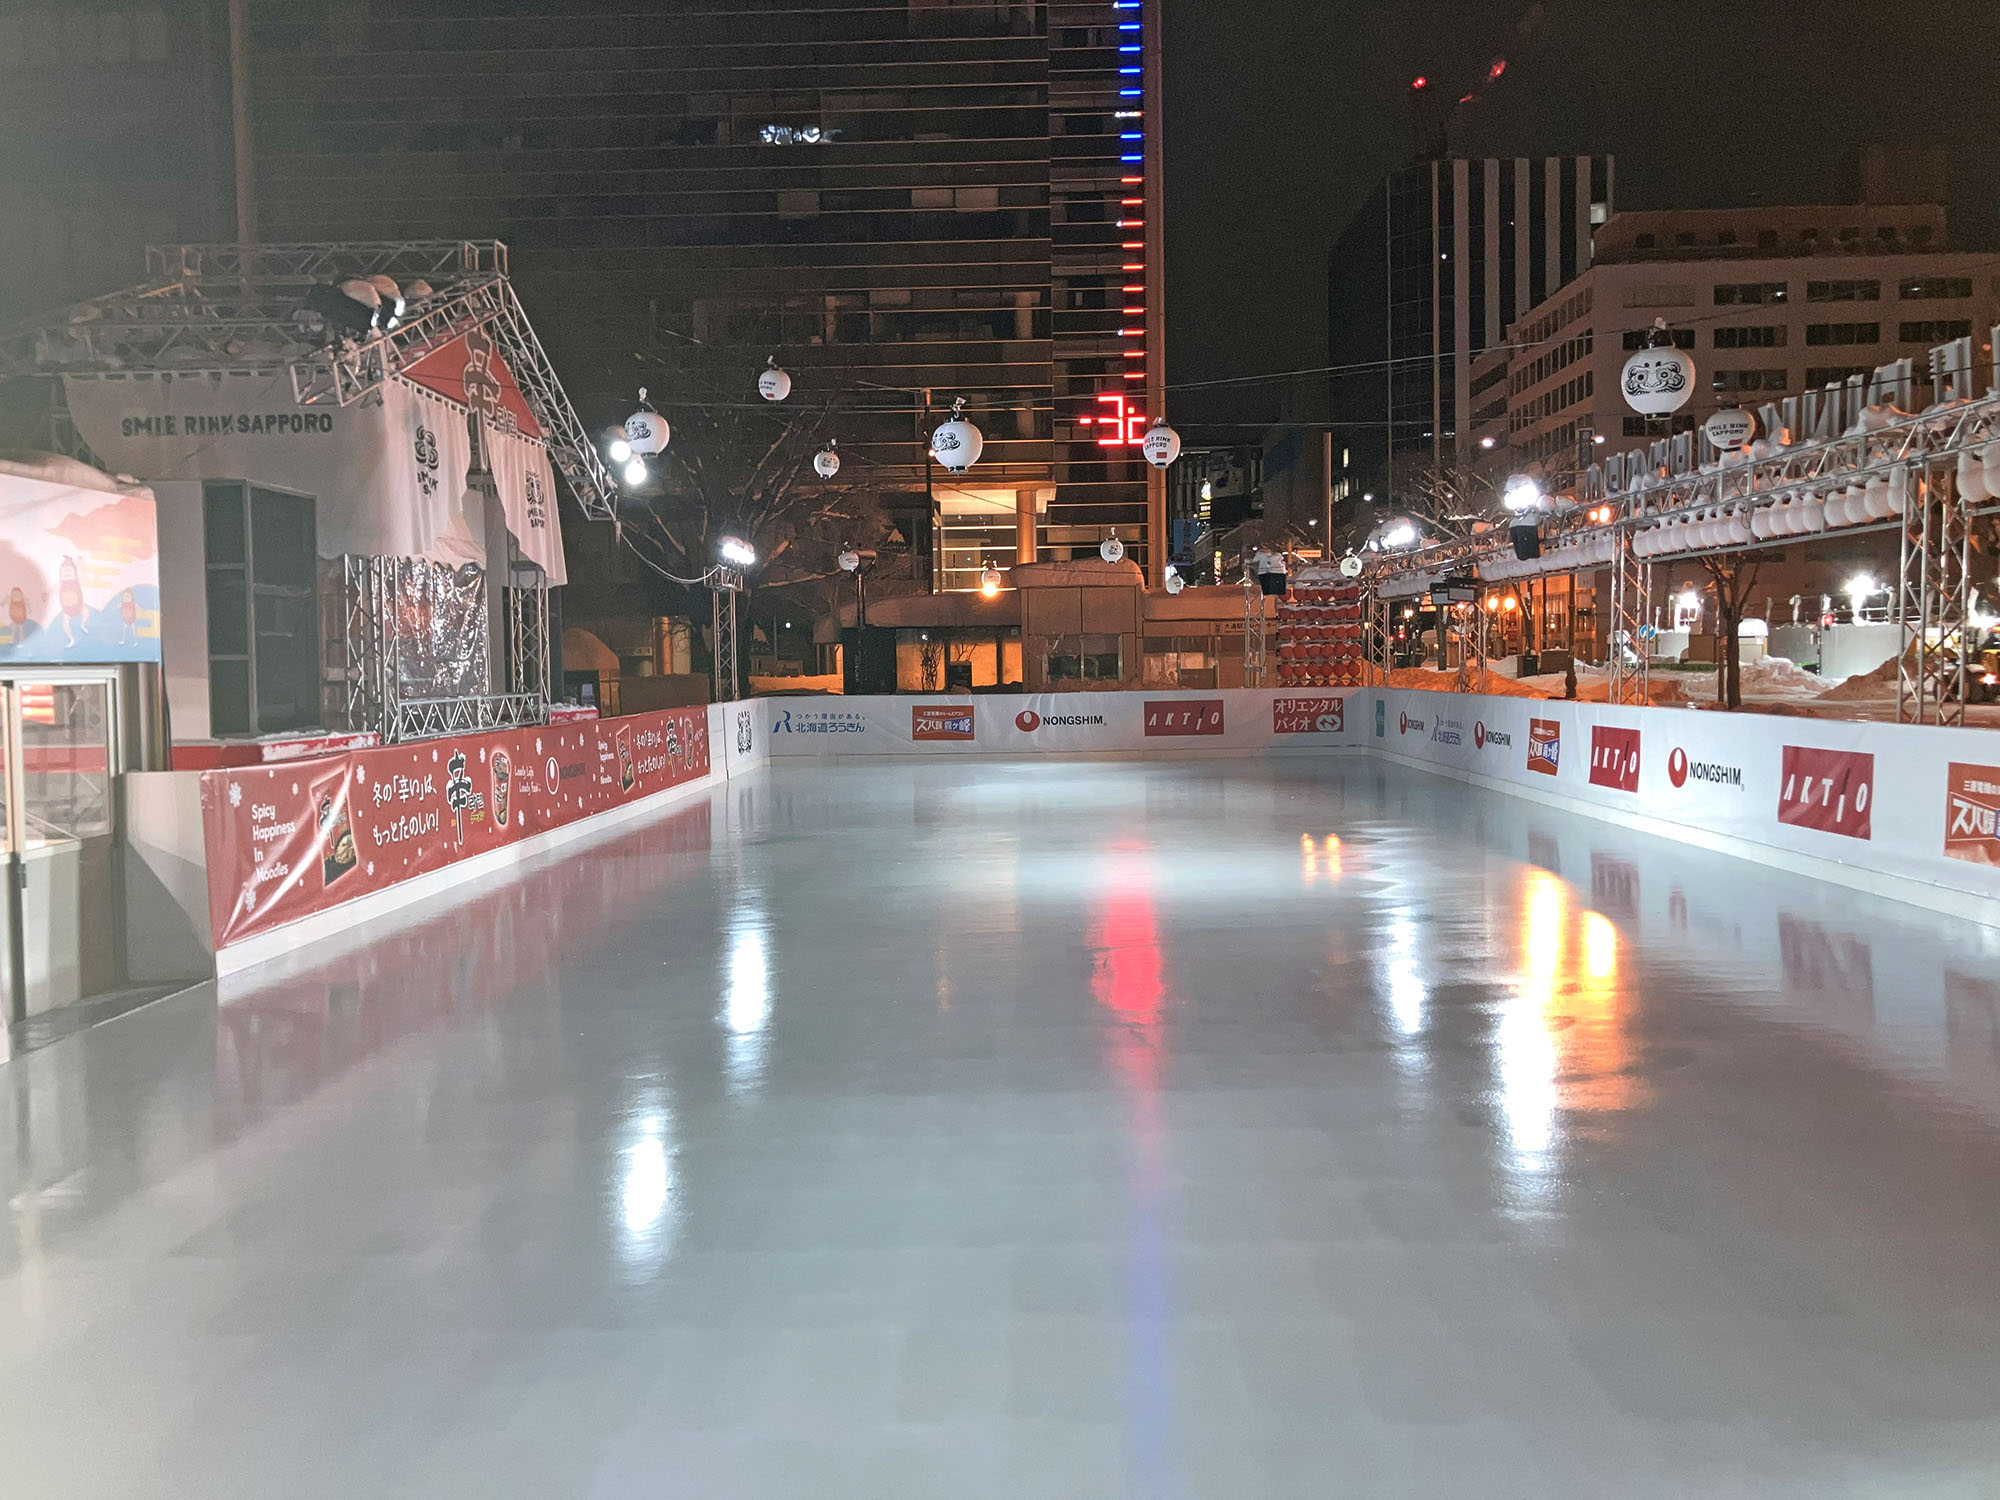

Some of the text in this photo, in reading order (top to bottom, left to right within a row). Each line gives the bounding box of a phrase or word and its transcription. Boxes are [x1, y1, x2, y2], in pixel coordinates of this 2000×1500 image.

[185, 414, 234, 436] RINK
[237, 413, 333, 434] SAPPORO
[1275, 699, 1342, 713] オリエンタル
[796, 722, 865, 733] 北海道ろうきん
[1043, 715, 1104, 727] NONGSHIM
[1148, 706, 1220, 731] AKTIO
[1275, 716, 1311, 731] バイオ
[1592, 741, 1638, 782] AKTIO
[1690, 762, 1742, 785] NONGSHIM
[1784, 768, 1868, 822] AKTIO
[252, 804, 276, 820] Spicy
[253, 821, 296, 842] Happiness
[373, 808, 439, 846] もっとたのしい!
[254, 847, 263, 862] In
[256, 863, 288, 883] Noodles
